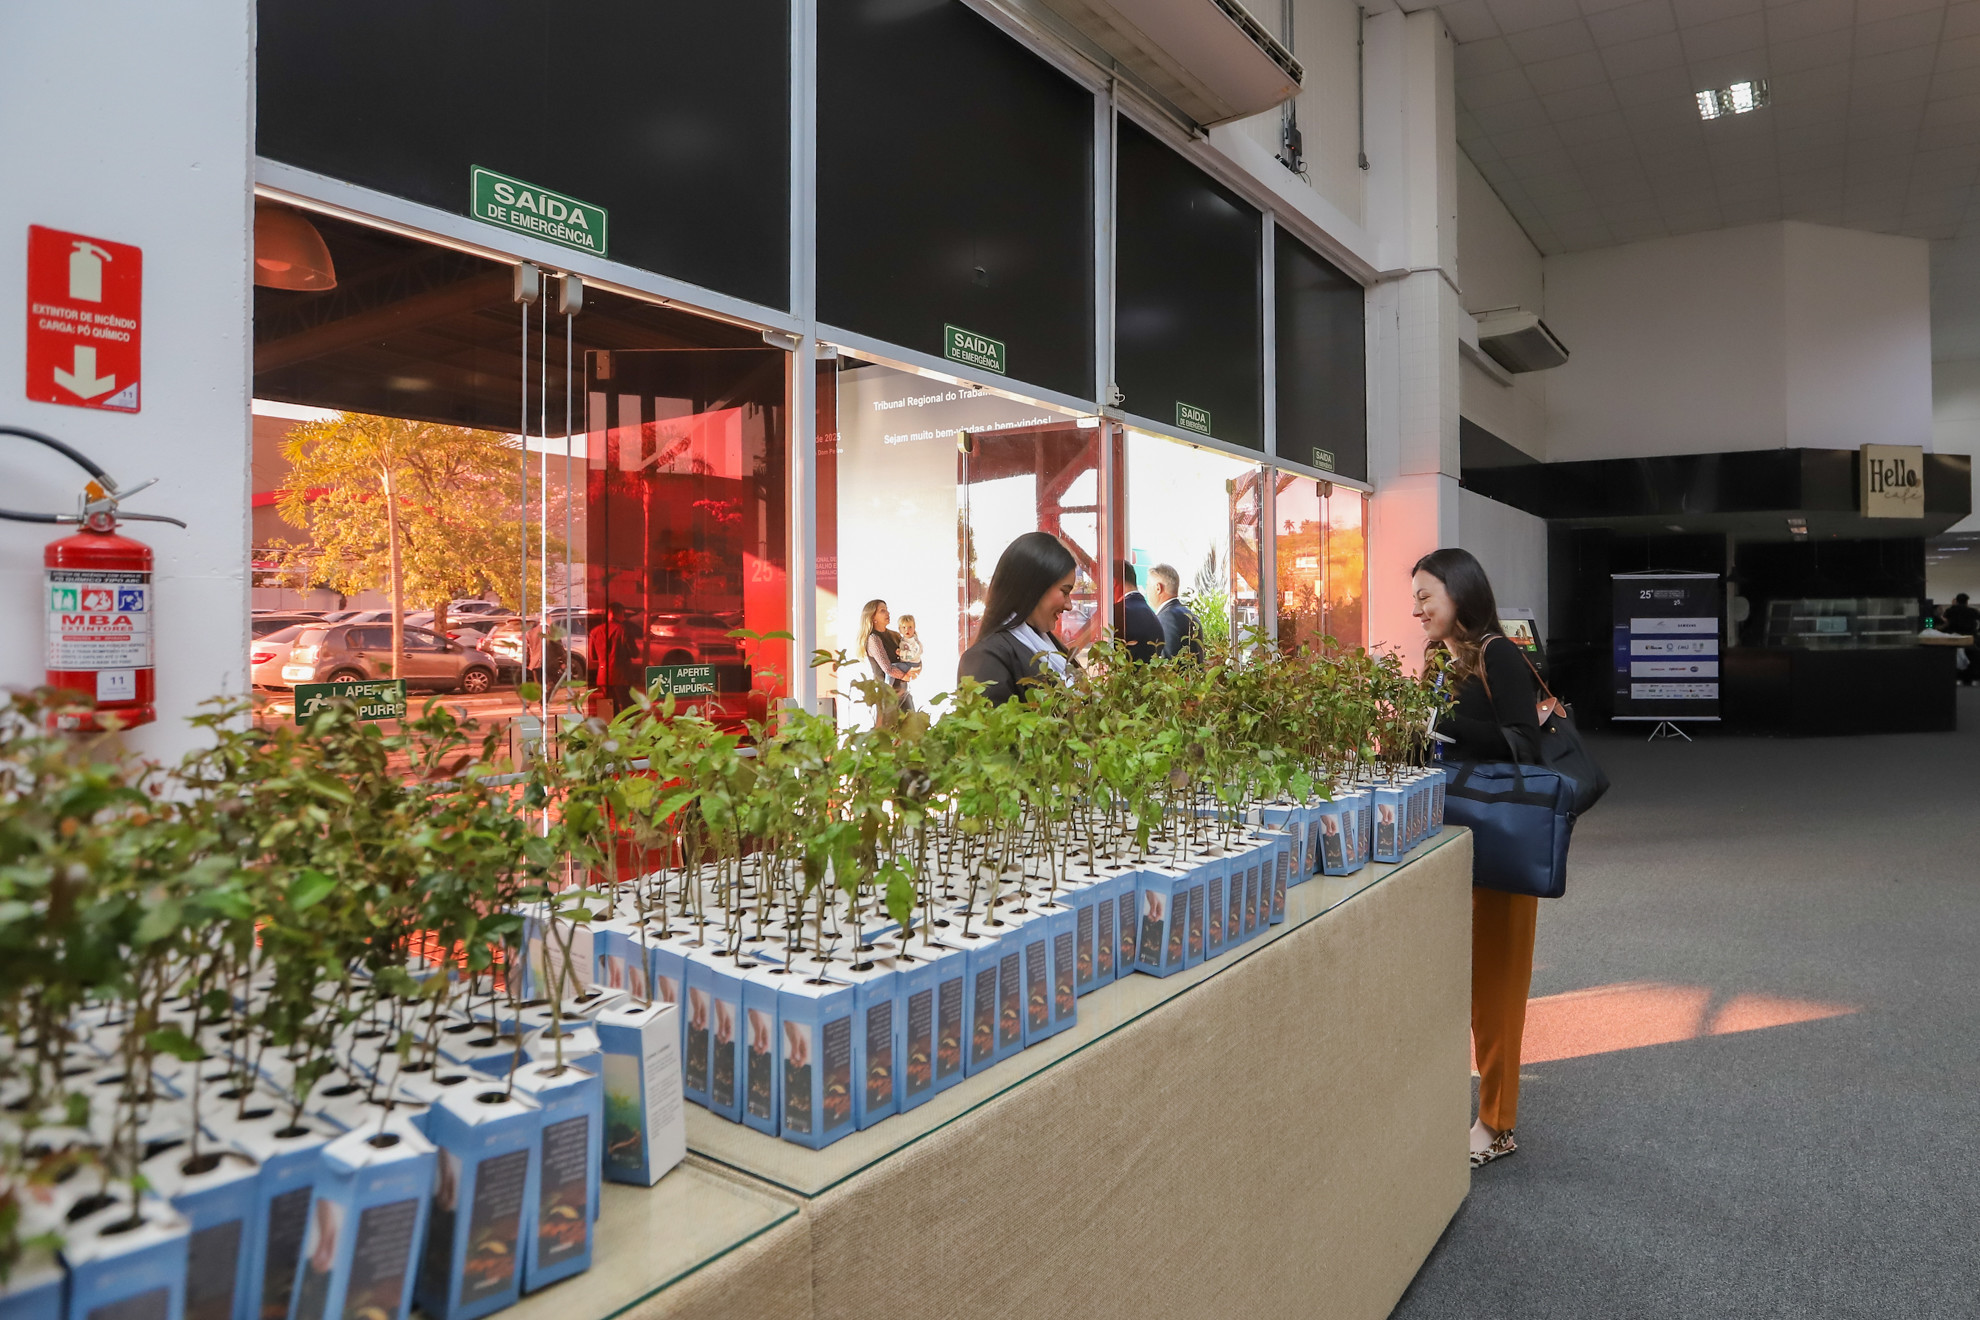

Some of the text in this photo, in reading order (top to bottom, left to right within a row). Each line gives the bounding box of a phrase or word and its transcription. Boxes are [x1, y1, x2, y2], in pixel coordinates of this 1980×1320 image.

[494, 182, 589, 230] SAÍDA
[487, 203, 595, 248] DE EMERGÊNCIA
[32, 303, 137, 330] EXTINTOR DE INCÊNDIO
[39, 318, 130, 342] CARGA: PÓ QUÍMICO
[954, 333, 998, 359] SAÍDA
[951, 347, 1000, 370] DE EMERGÊNCIA
[873, 397, 906, 411] Tribunal
[907, 392, 944, 407] Regional
[945, 391, 957, 401] do
[824, 432, 842, 443] 2025
[884, 434, 909, 446] Sejam
[910, 430, 934, 442] muito
[62, 615, 132, 625] MBA
[111, 676, 124, 685] 11
[677, 667, 710, 677] APERTE
